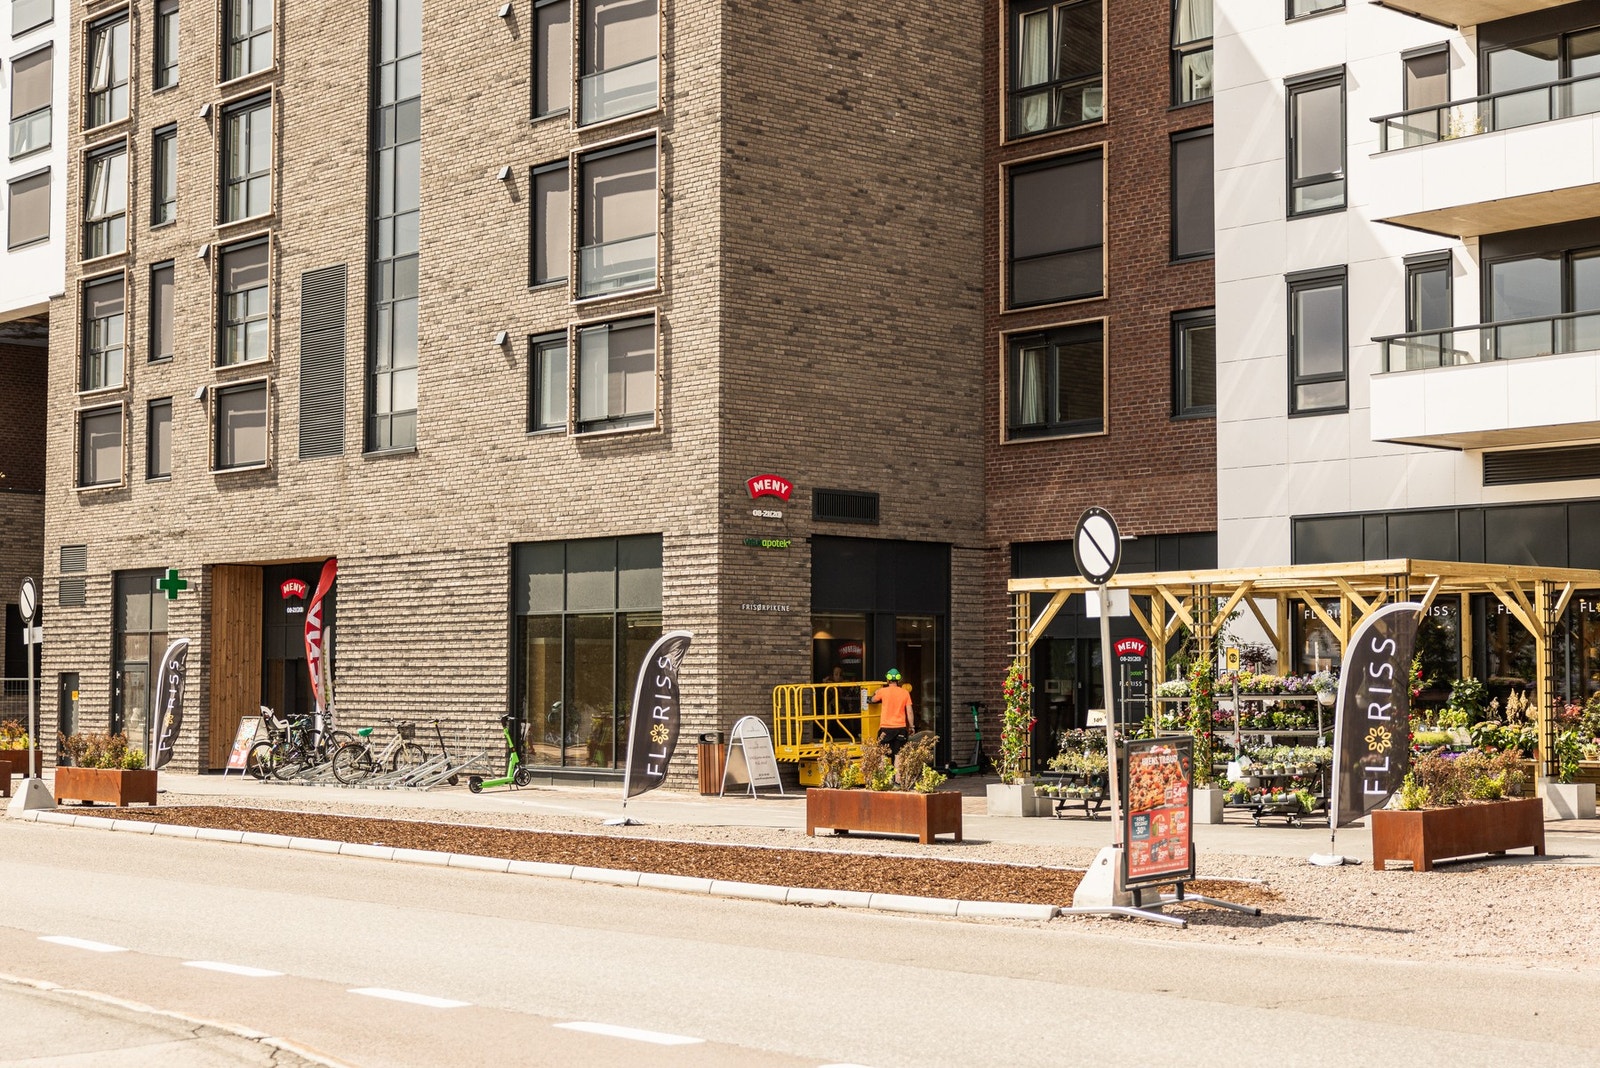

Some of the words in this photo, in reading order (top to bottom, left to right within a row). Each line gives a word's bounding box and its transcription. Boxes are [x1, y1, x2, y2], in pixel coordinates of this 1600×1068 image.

[752, 479, 788, 494] MENY
[283, 582, 304, 593] MENY
[741, 603, 790, 611] FRISØRPIKENE
[1117, 641, 1144, 652] MENY
